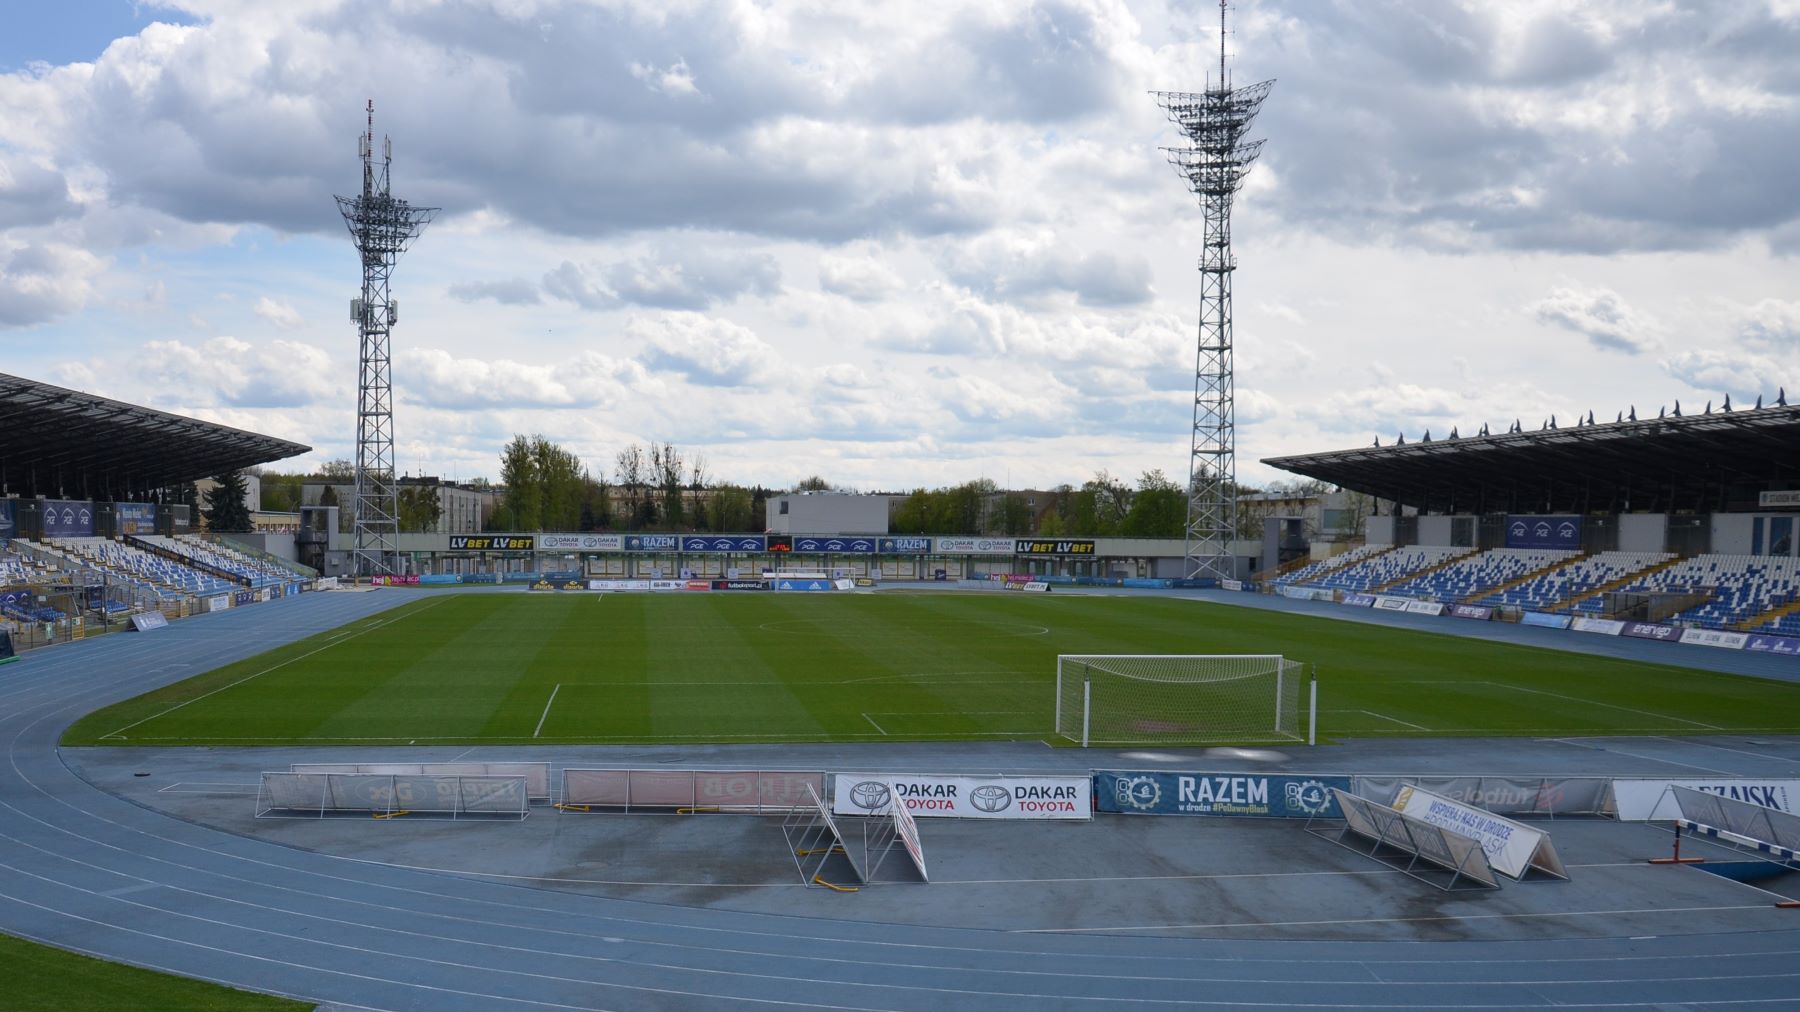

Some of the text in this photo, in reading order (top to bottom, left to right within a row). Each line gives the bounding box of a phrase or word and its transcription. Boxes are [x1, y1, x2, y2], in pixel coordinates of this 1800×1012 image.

[643, 537, 675, 547] RAZEM
[896, 539, 927, 549] RAZEM
[896, 783, 957, 798] DAKAR
[1015, 786, 1077, 799] DAKAR
[1178, 776, 1268, 804] RAZEM
[903, 799, 955, 811] OYOTA
[1018, 801, 1075, 812] TOYOTA
[1186, 803, 1211, 812] drodze
[1461, 811, 1479, 828] NAS
[1484, 820, 1515, 840] DRODZE
